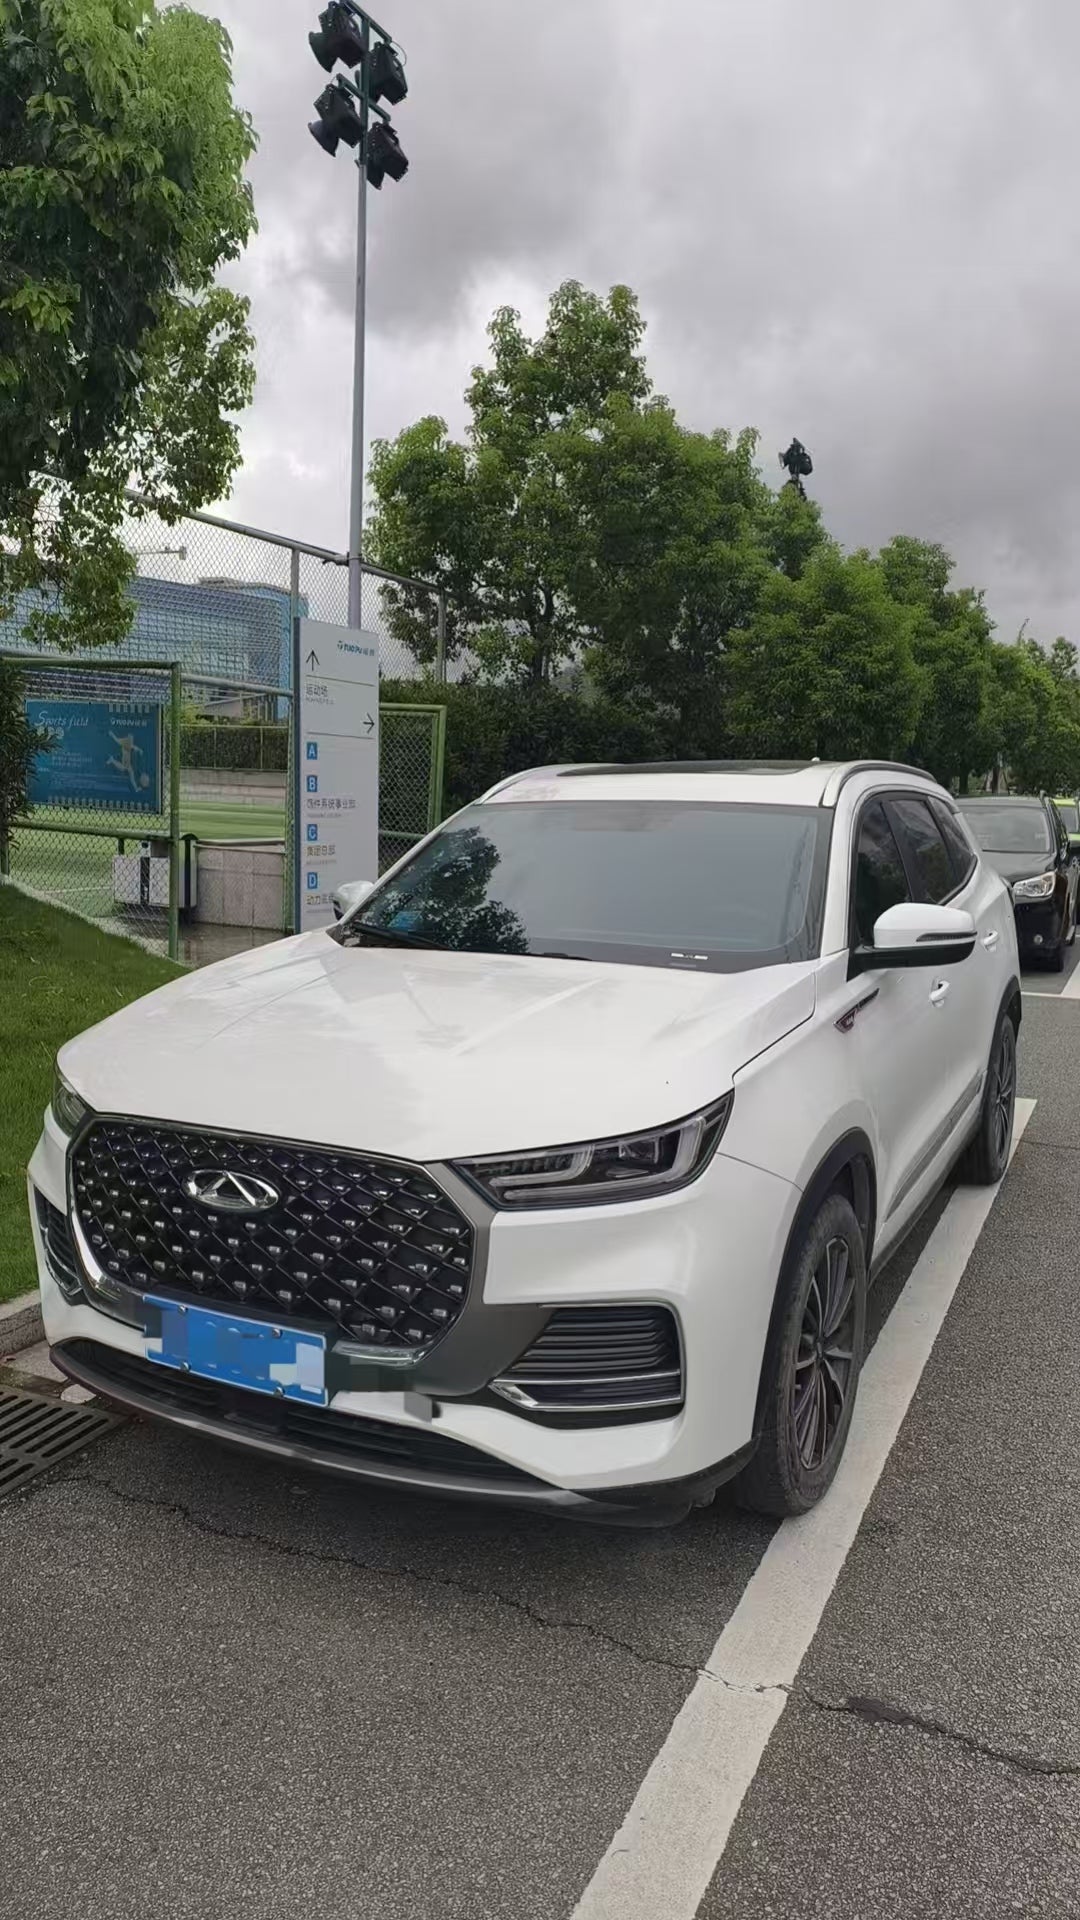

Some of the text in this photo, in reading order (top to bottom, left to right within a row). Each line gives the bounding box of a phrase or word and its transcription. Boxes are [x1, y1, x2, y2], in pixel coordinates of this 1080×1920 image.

[34, 711, 67, 727] Sports
[308, 743, 316, 758] A
[308, 776, 316, 791] B
[308, 825, 316, 839] C
[309, 873, 316, 888] D
